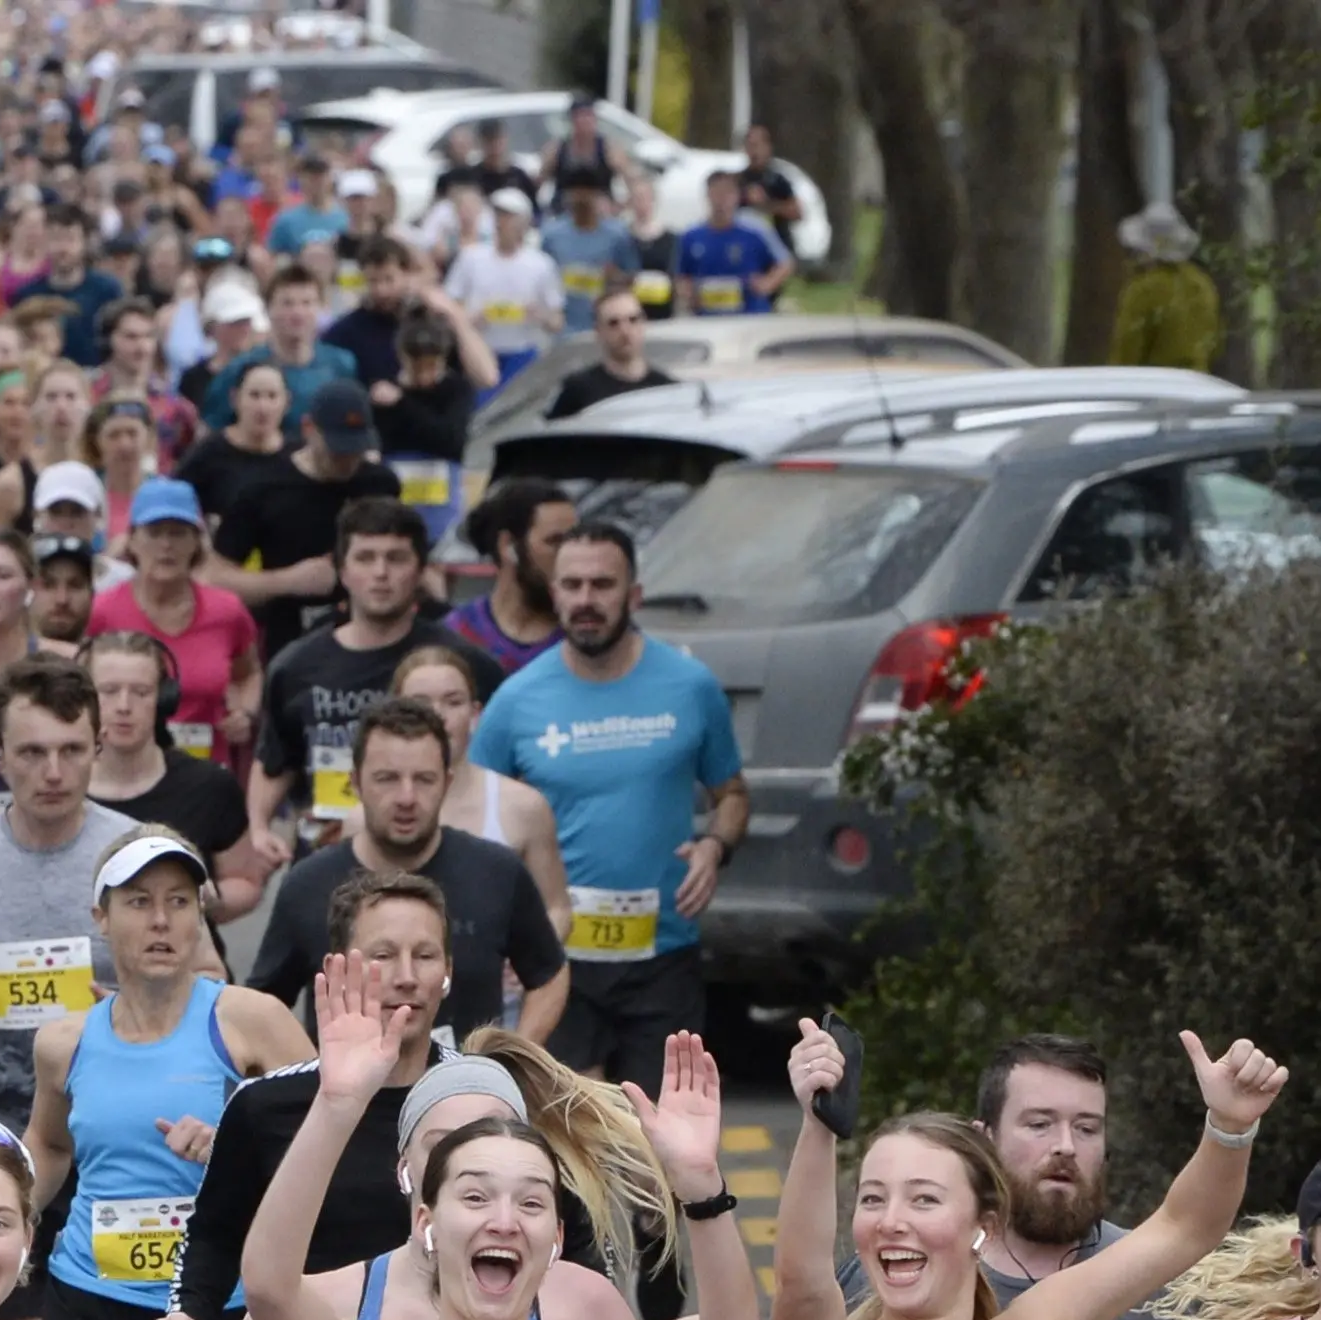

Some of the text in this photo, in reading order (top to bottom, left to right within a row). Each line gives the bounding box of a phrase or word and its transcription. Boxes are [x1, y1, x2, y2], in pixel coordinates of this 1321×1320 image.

[591, 921, 625, 944] 713
[9, 980, 57, 1006] 534
[130, 1241, 179, 1270] 654
